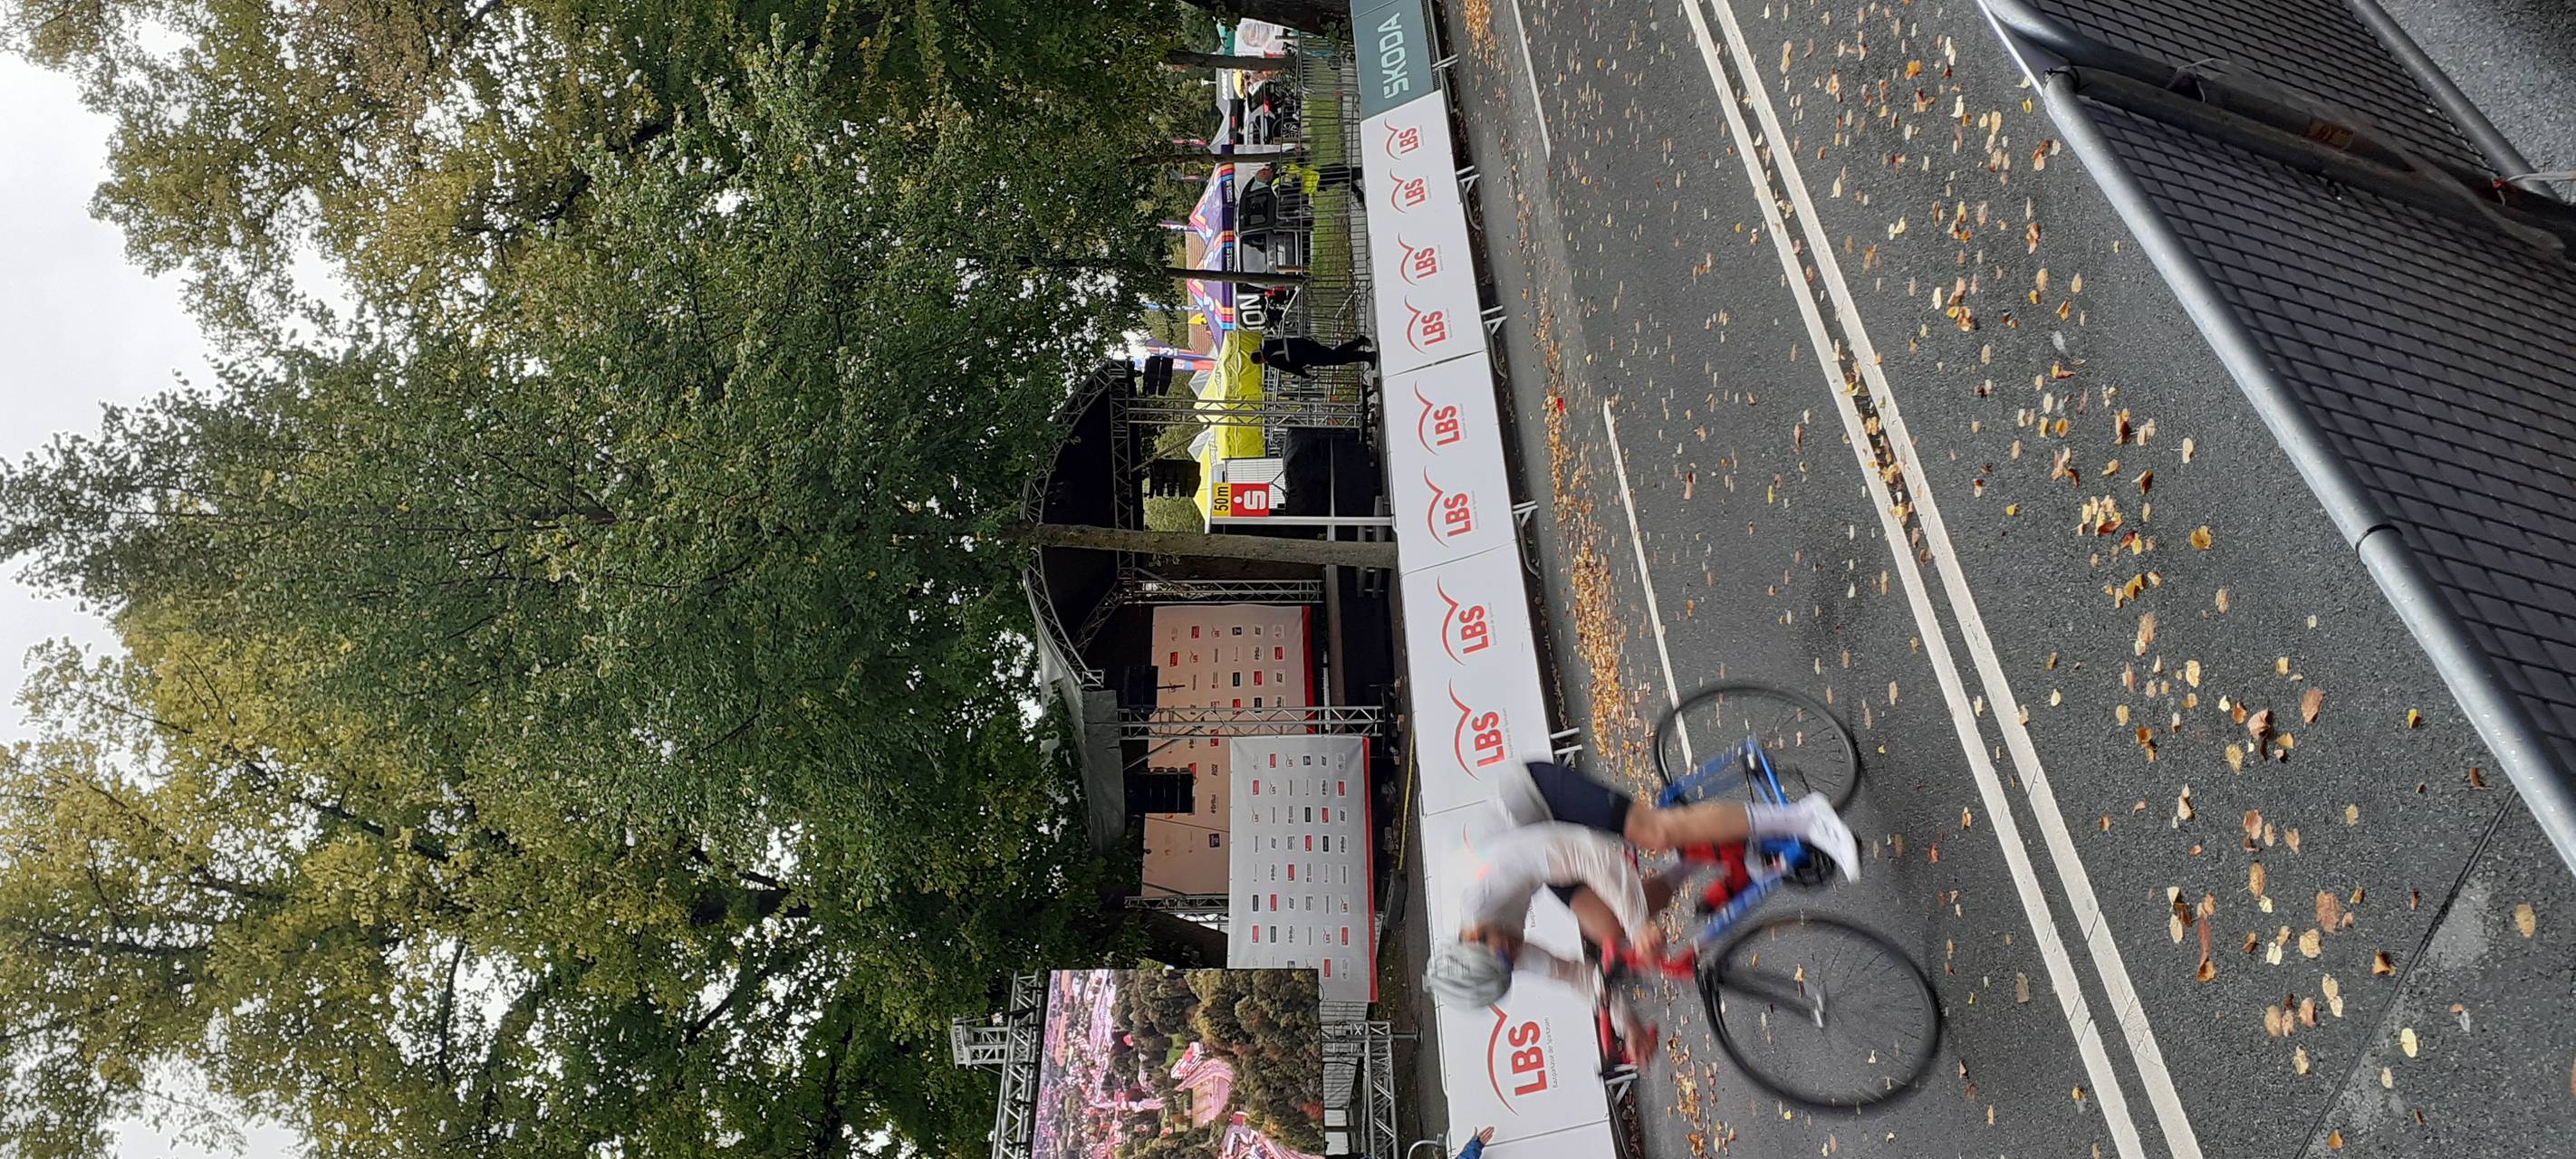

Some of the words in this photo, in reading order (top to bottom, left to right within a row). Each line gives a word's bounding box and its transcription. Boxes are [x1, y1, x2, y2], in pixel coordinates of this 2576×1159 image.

[1399, 127, 1419, 154] LBS
[1404, 177, 1426, 207] LBS
[1413, 247, 1437, 279] LBS
[1420, 311, 1446, 346] LBS
[1433, 406, 1460, 446] LBS
[1443, 493, 1471, 538] LBS
[1458, 605, 1489, 654] LBS
[1471, 712, 1505, 768] LBS
[1507, 1021, 1547, 1096] LBS
